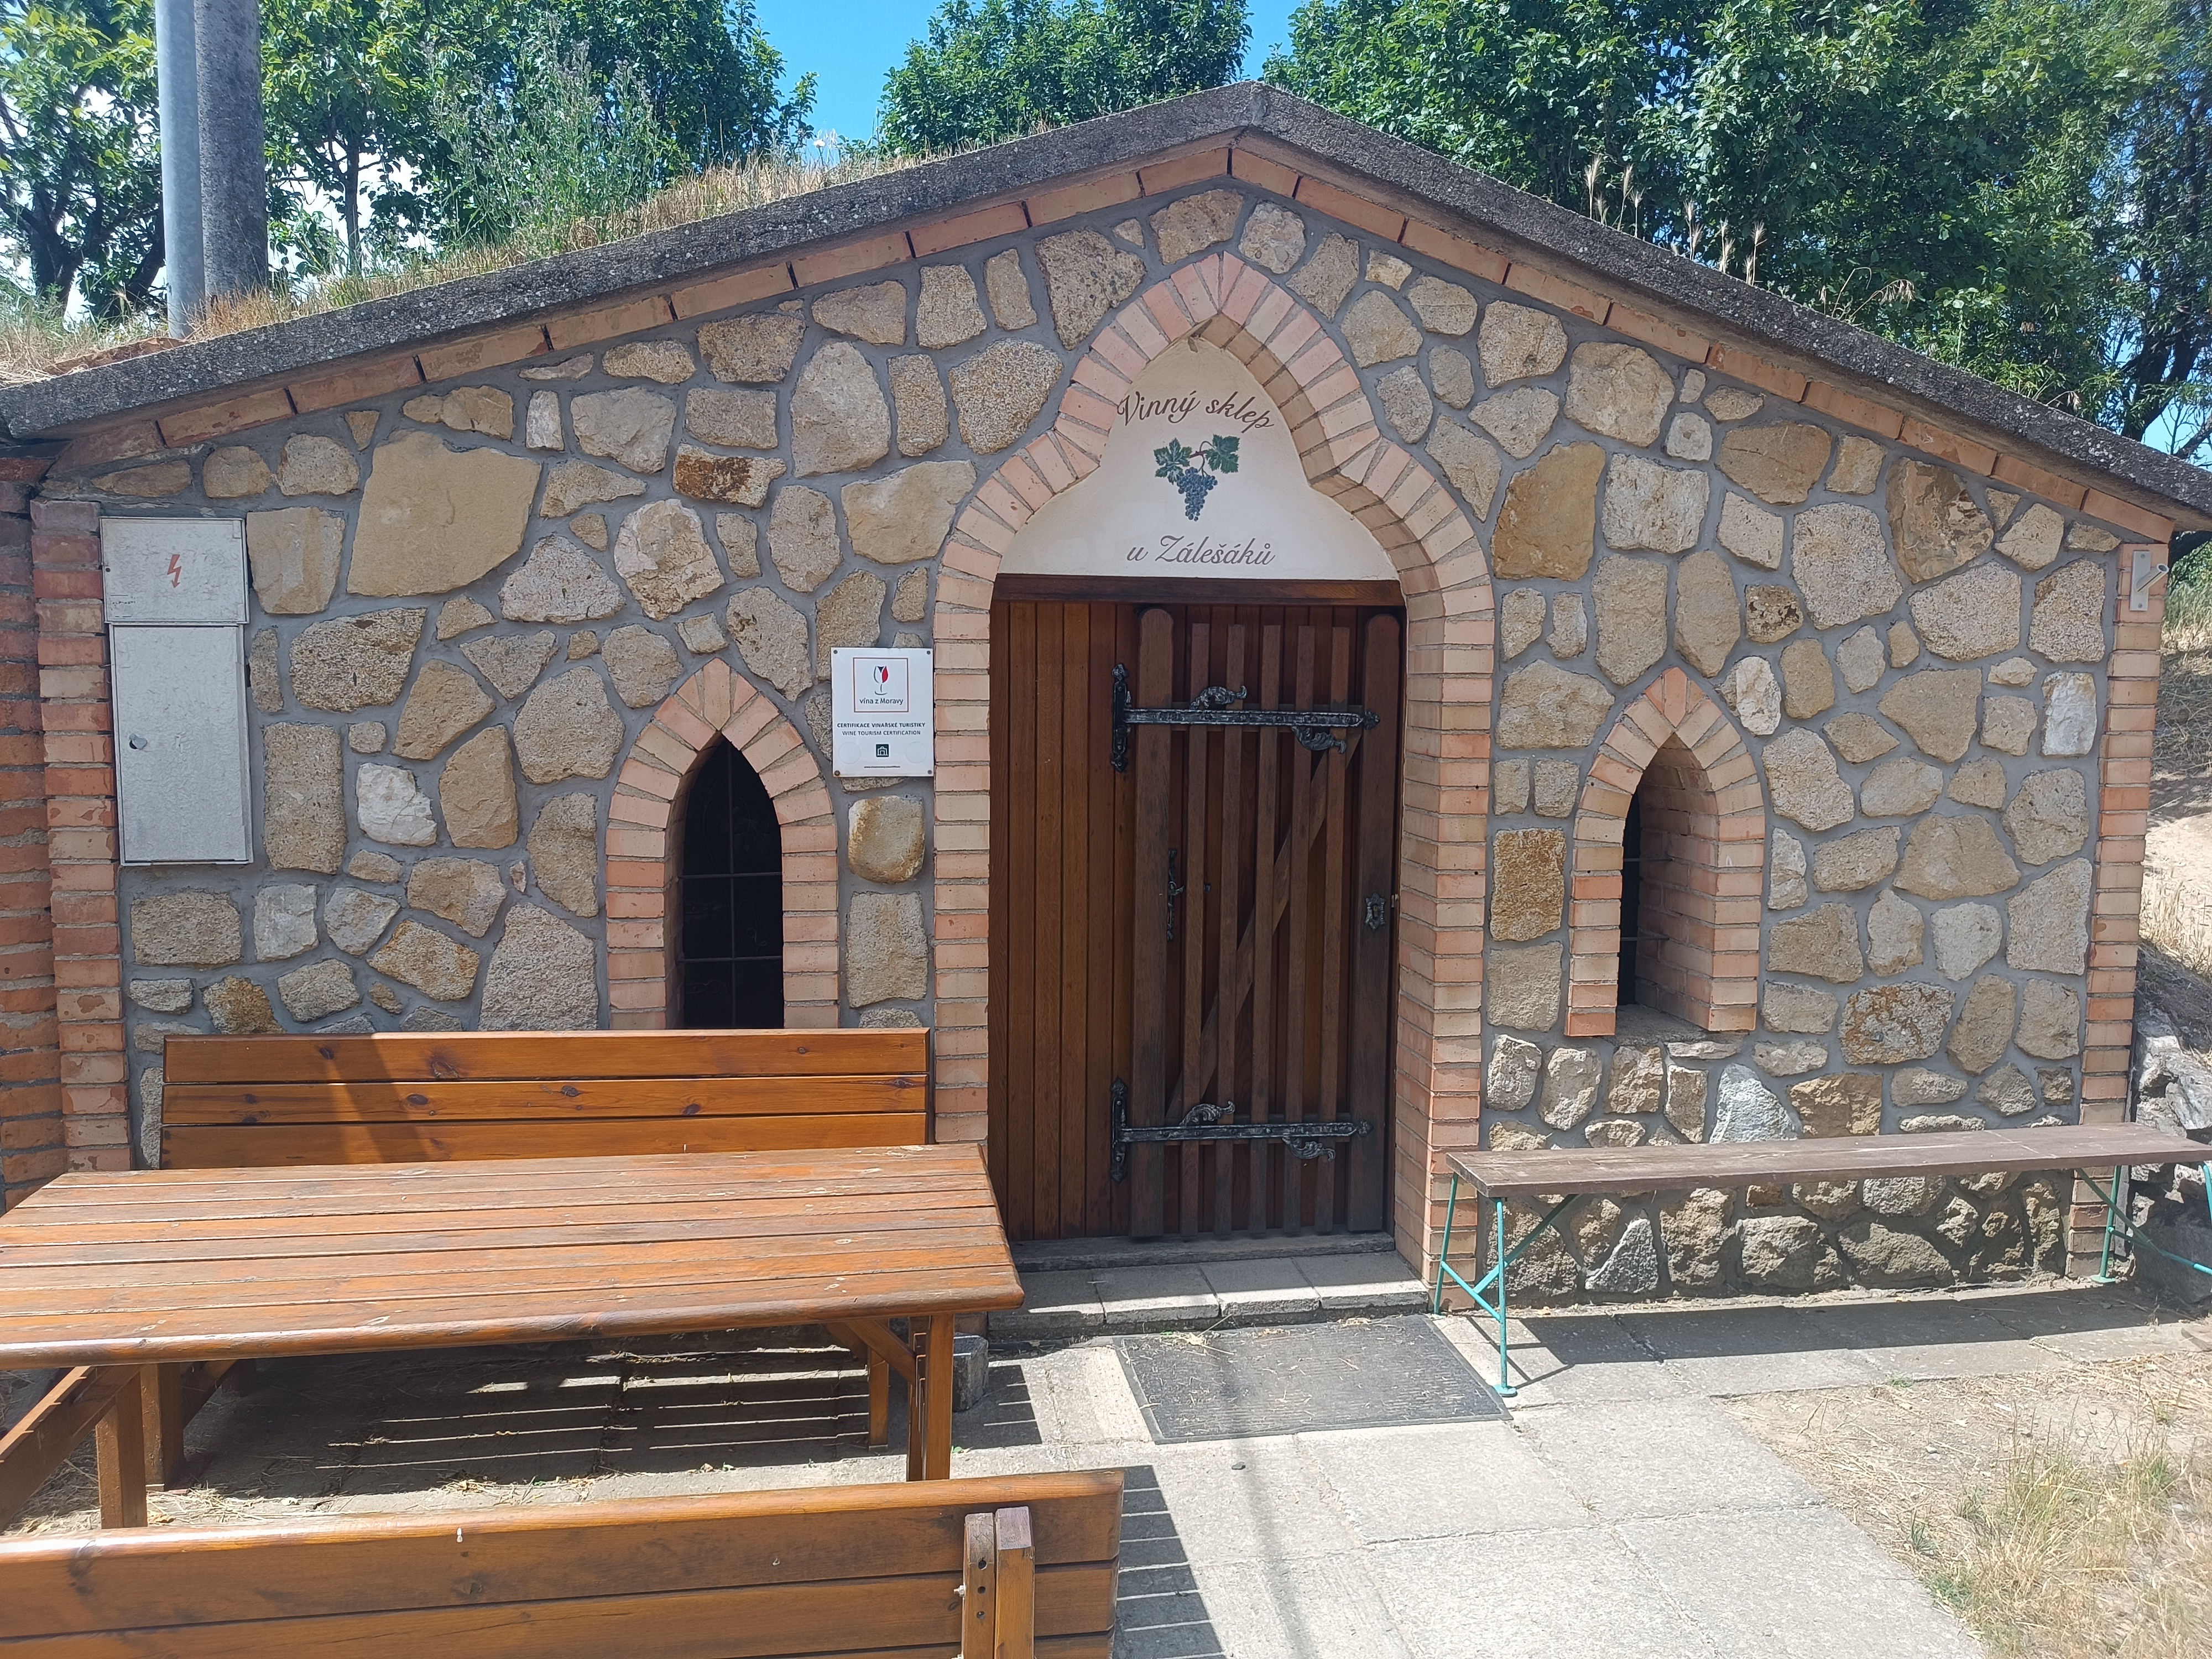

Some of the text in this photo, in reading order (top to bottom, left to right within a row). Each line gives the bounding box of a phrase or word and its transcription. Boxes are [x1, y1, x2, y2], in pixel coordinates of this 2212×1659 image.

[1117, 390, 1275, 434] Vinný sklep
[1126, 535, 1275, 565] u Zálešáků
[880, 697, 904, 706] Moravy
